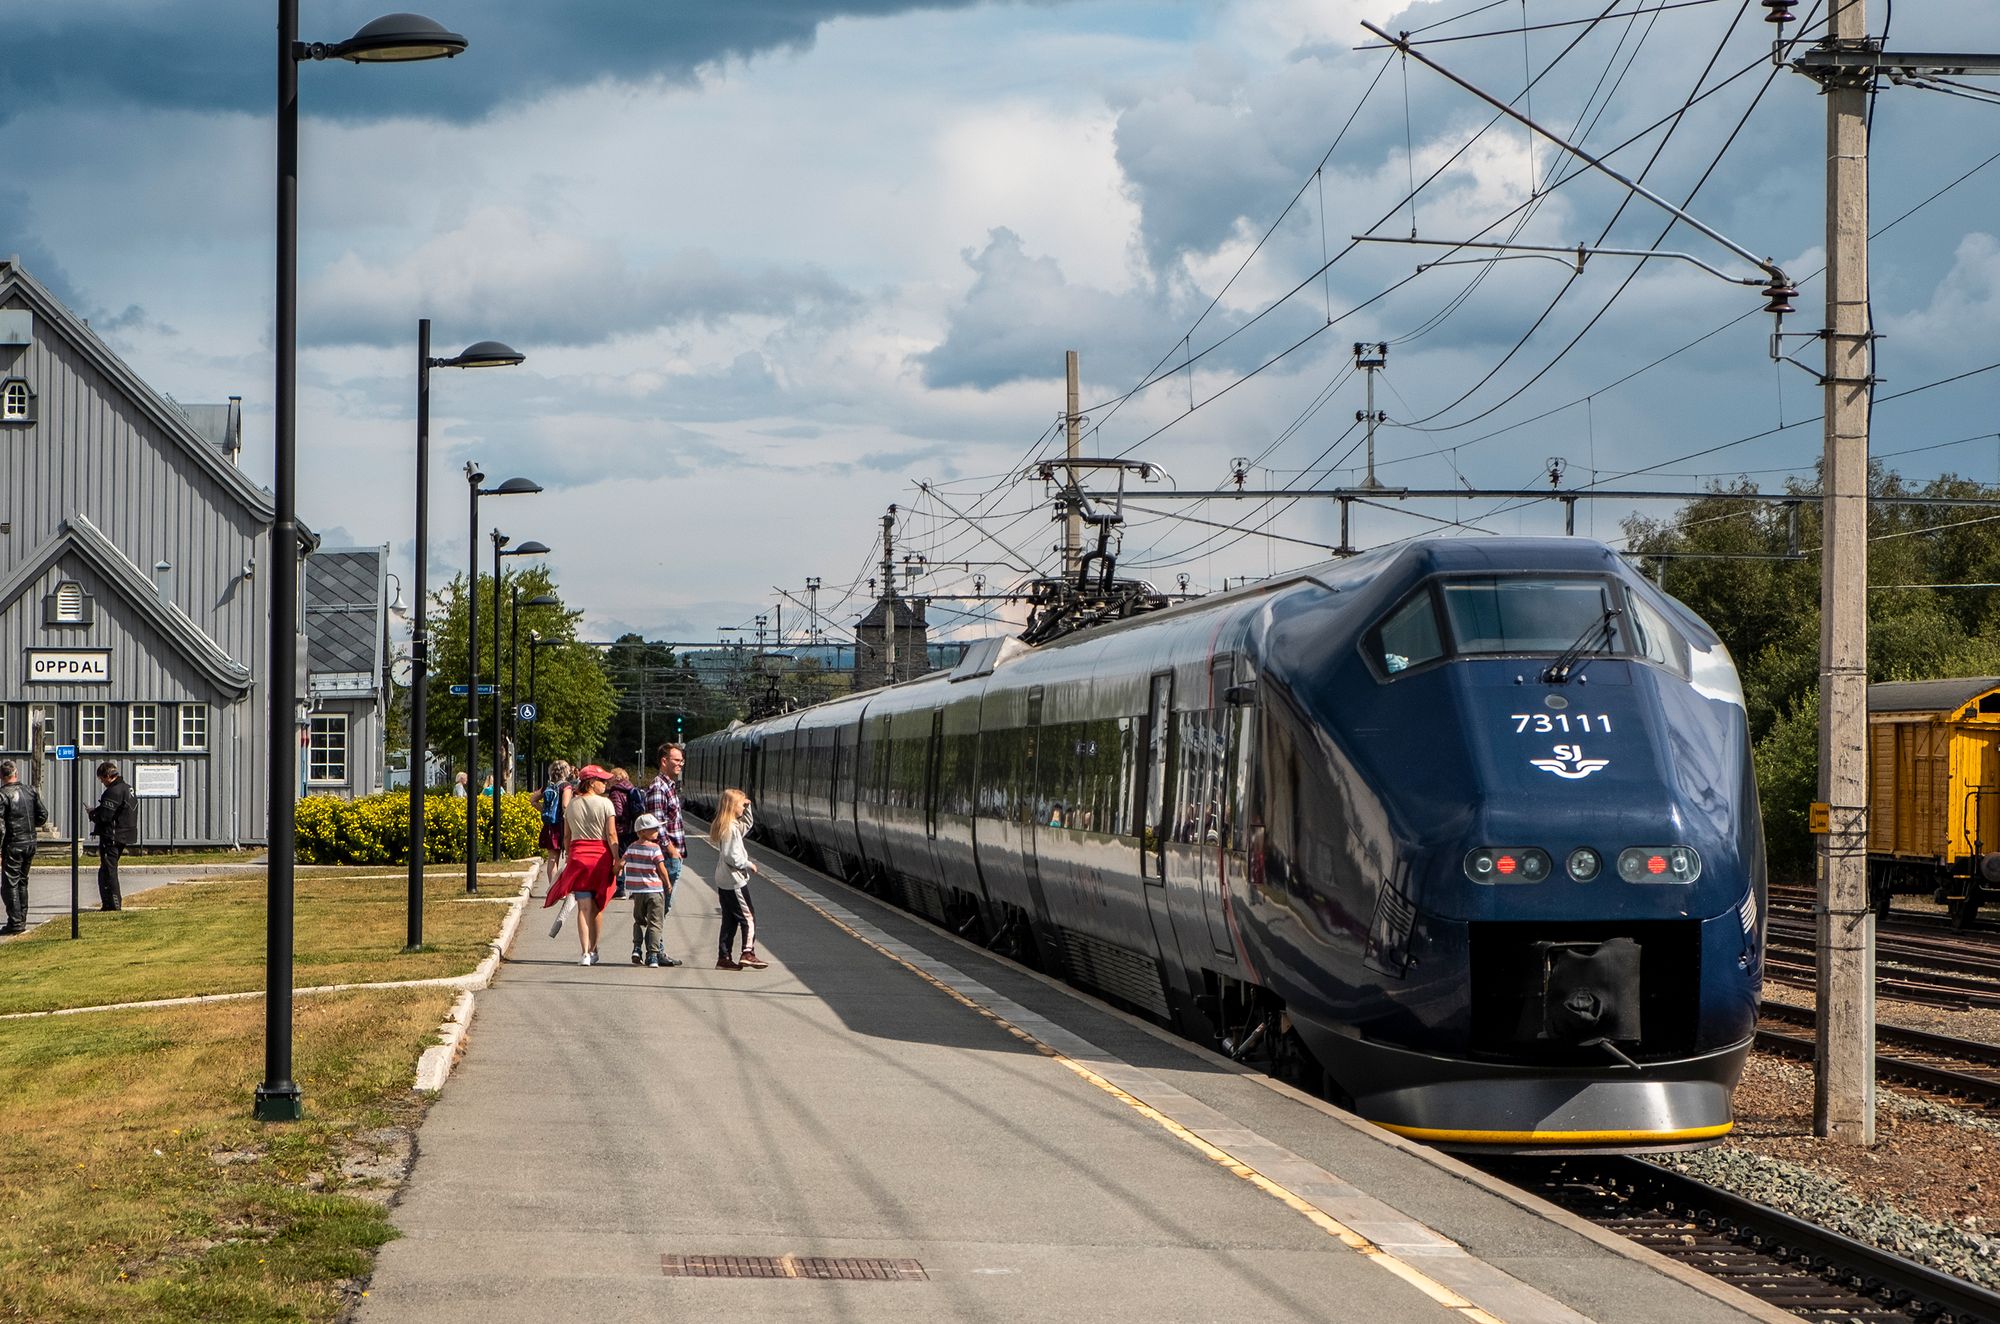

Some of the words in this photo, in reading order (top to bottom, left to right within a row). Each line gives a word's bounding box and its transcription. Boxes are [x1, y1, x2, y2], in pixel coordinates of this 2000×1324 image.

[35, 660, 104, 673] OPPDAL
[1511, 714, 1612, 733] 73111
[1553, 744, 1582, 762] SJ
